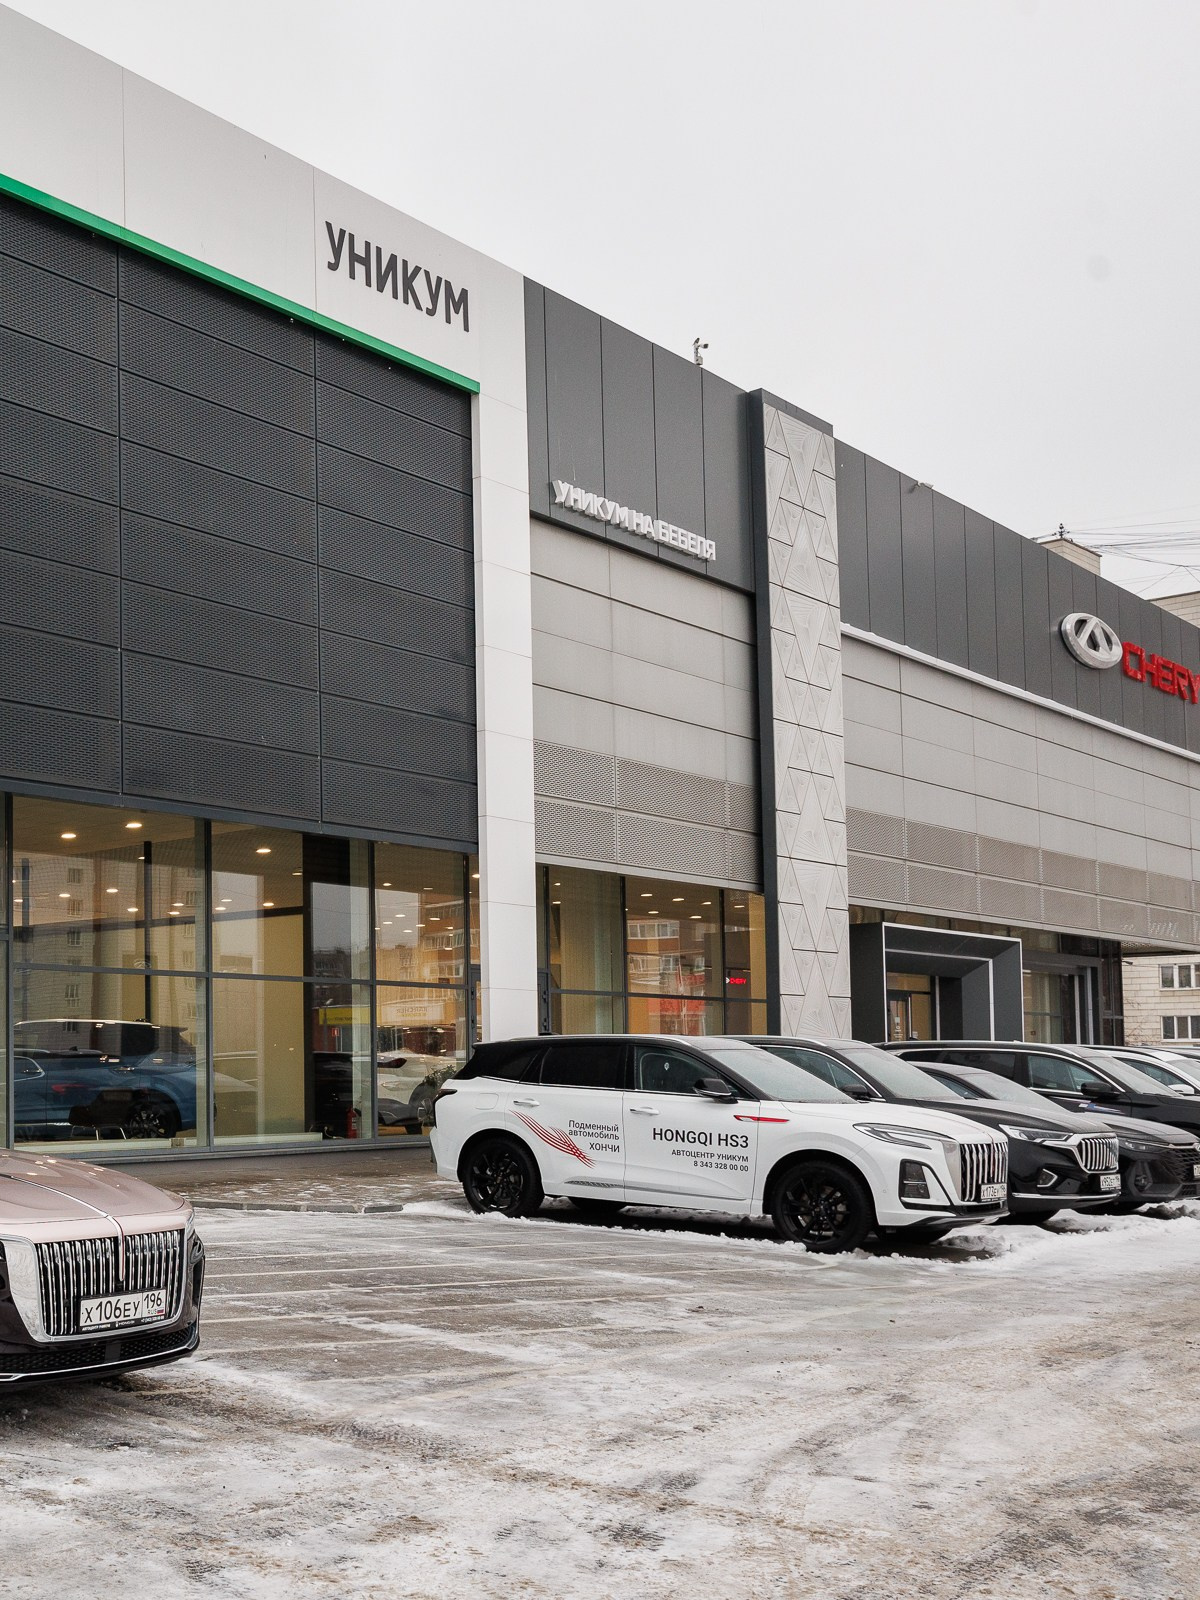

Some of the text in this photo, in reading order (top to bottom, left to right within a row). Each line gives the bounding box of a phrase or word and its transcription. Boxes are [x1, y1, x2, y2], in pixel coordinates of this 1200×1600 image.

[325, 220, 470, 332] УНИКУМ
[552, 479, 716, 561] УНИКУМ НА БЕБЕЛЯ
[1122, 641, 1200, 704] CHERY
[568, 1120, 619, 1132] Подменный
[568, 1130, 620, 1140] автомобиль
[652, 1127, 749, 1148] HONGQI HS3
[589, 1142, 620, 1152] ХОНЧИ
[672, 1149, 749, 1162] АВТОЦЕНТР УНИКУМ
[714, 1162, 727, 1170] 328
[84, 1292, 162, 1323] Х106ЕУ 196
